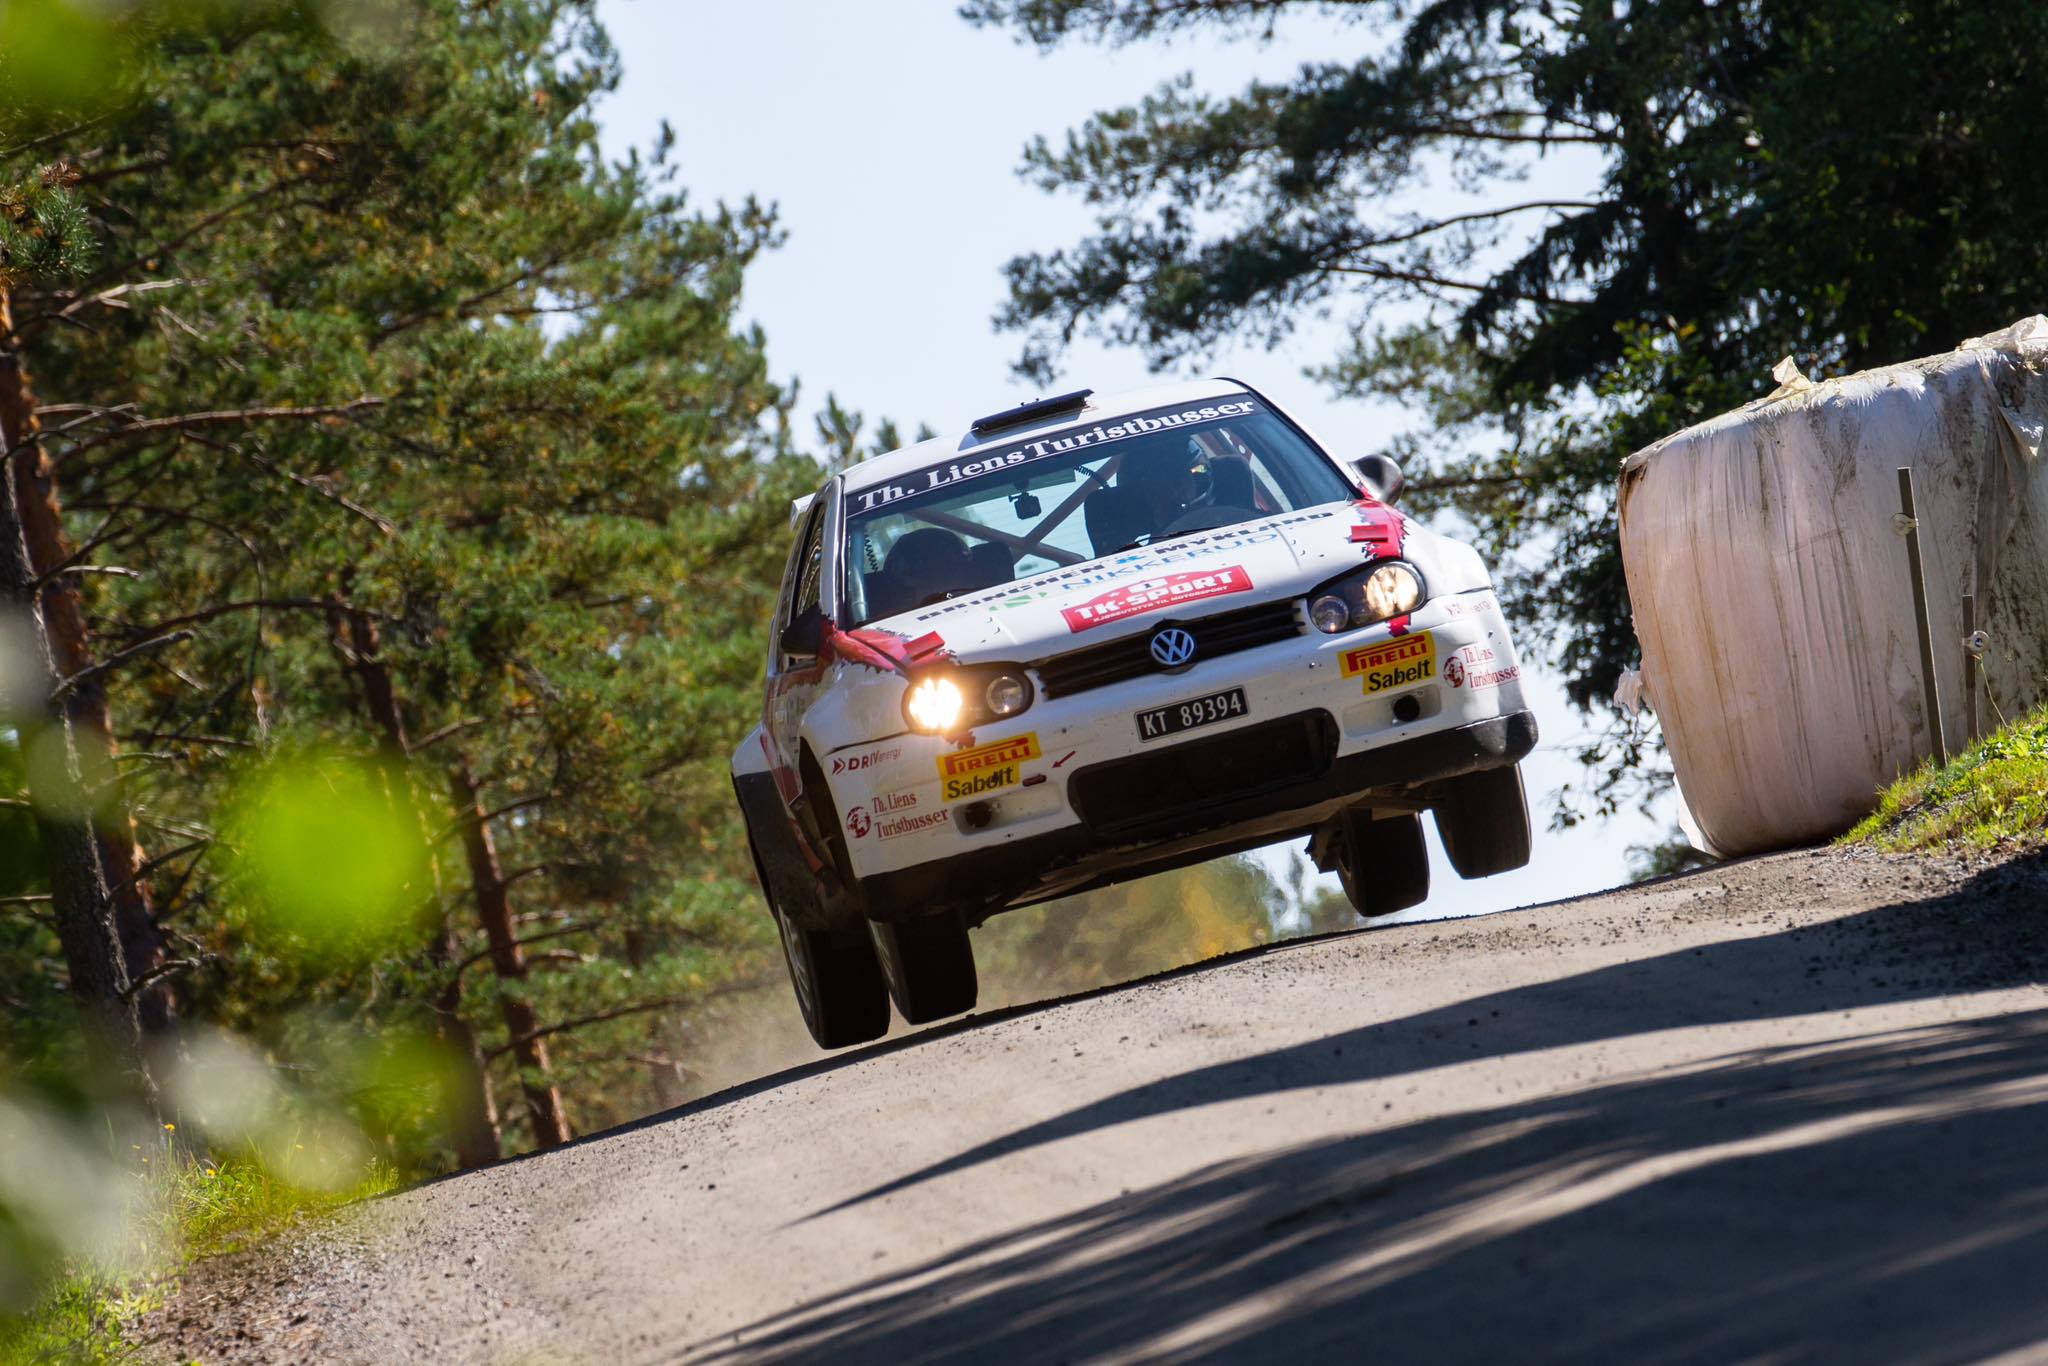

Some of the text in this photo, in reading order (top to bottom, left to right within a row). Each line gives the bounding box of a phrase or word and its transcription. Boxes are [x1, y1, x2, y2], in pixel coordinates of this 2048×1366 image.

[857, 400, 1254, 510] Th. Liens Turistbusser
[1061, 533, 1279, 591] NIKKERUD
[1075, 571, 1233, 619] TK-SPORT
[1346, 635, 1427, 672] PIRELLI
[1368, 659, 1431, 691] Sabelt
[1143, 692, 1241, 736] KT 89394
[945, 737, 1031, 775] PIRELLI
[872, 792, 917, 814] Th. Liens
[874, 807, 950, 838] Turistbusser
